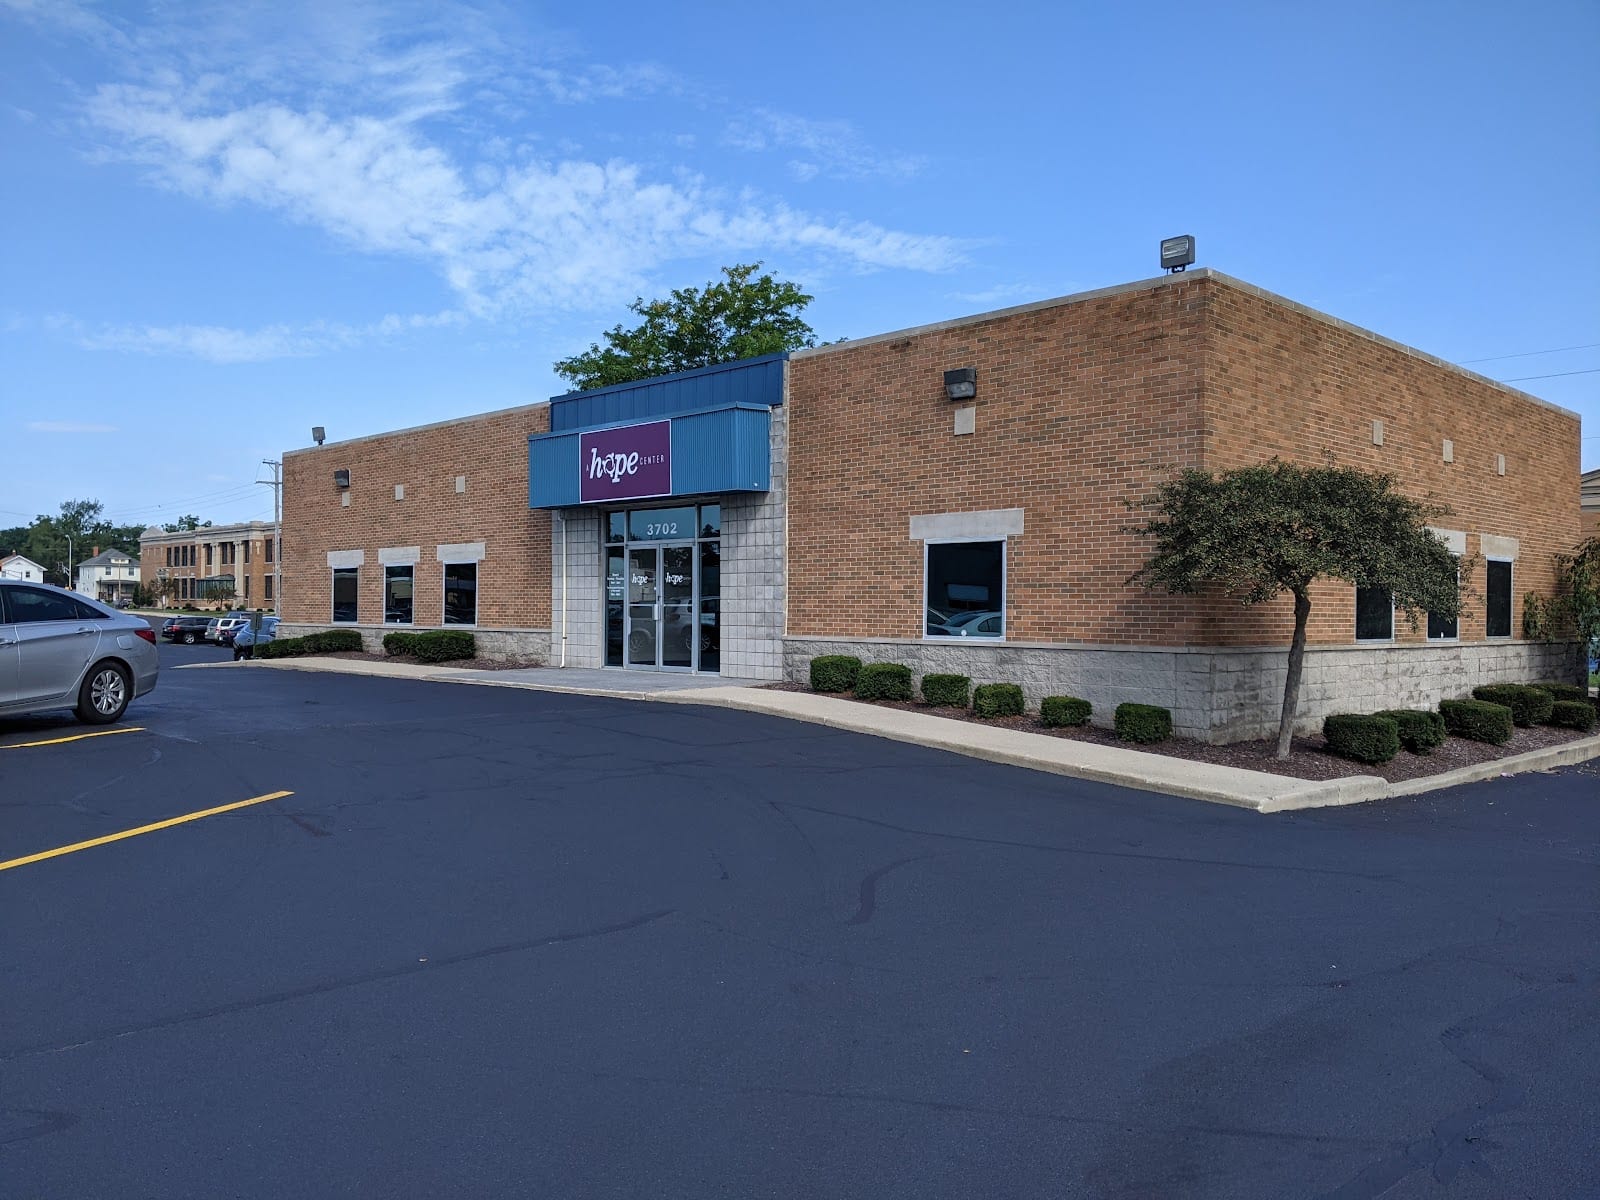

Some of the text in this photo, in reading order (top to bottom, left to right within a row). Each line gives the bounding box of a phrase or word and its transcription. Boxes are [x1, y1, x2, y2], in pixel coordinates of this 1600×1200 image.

[589, 447, 639, 484] hope
[639, 455, 665, 466] CENTER
[646, 522, 678, 536] 3702
[631, 573, 648, 585] hope
[666, 572, 683, 584] hope
